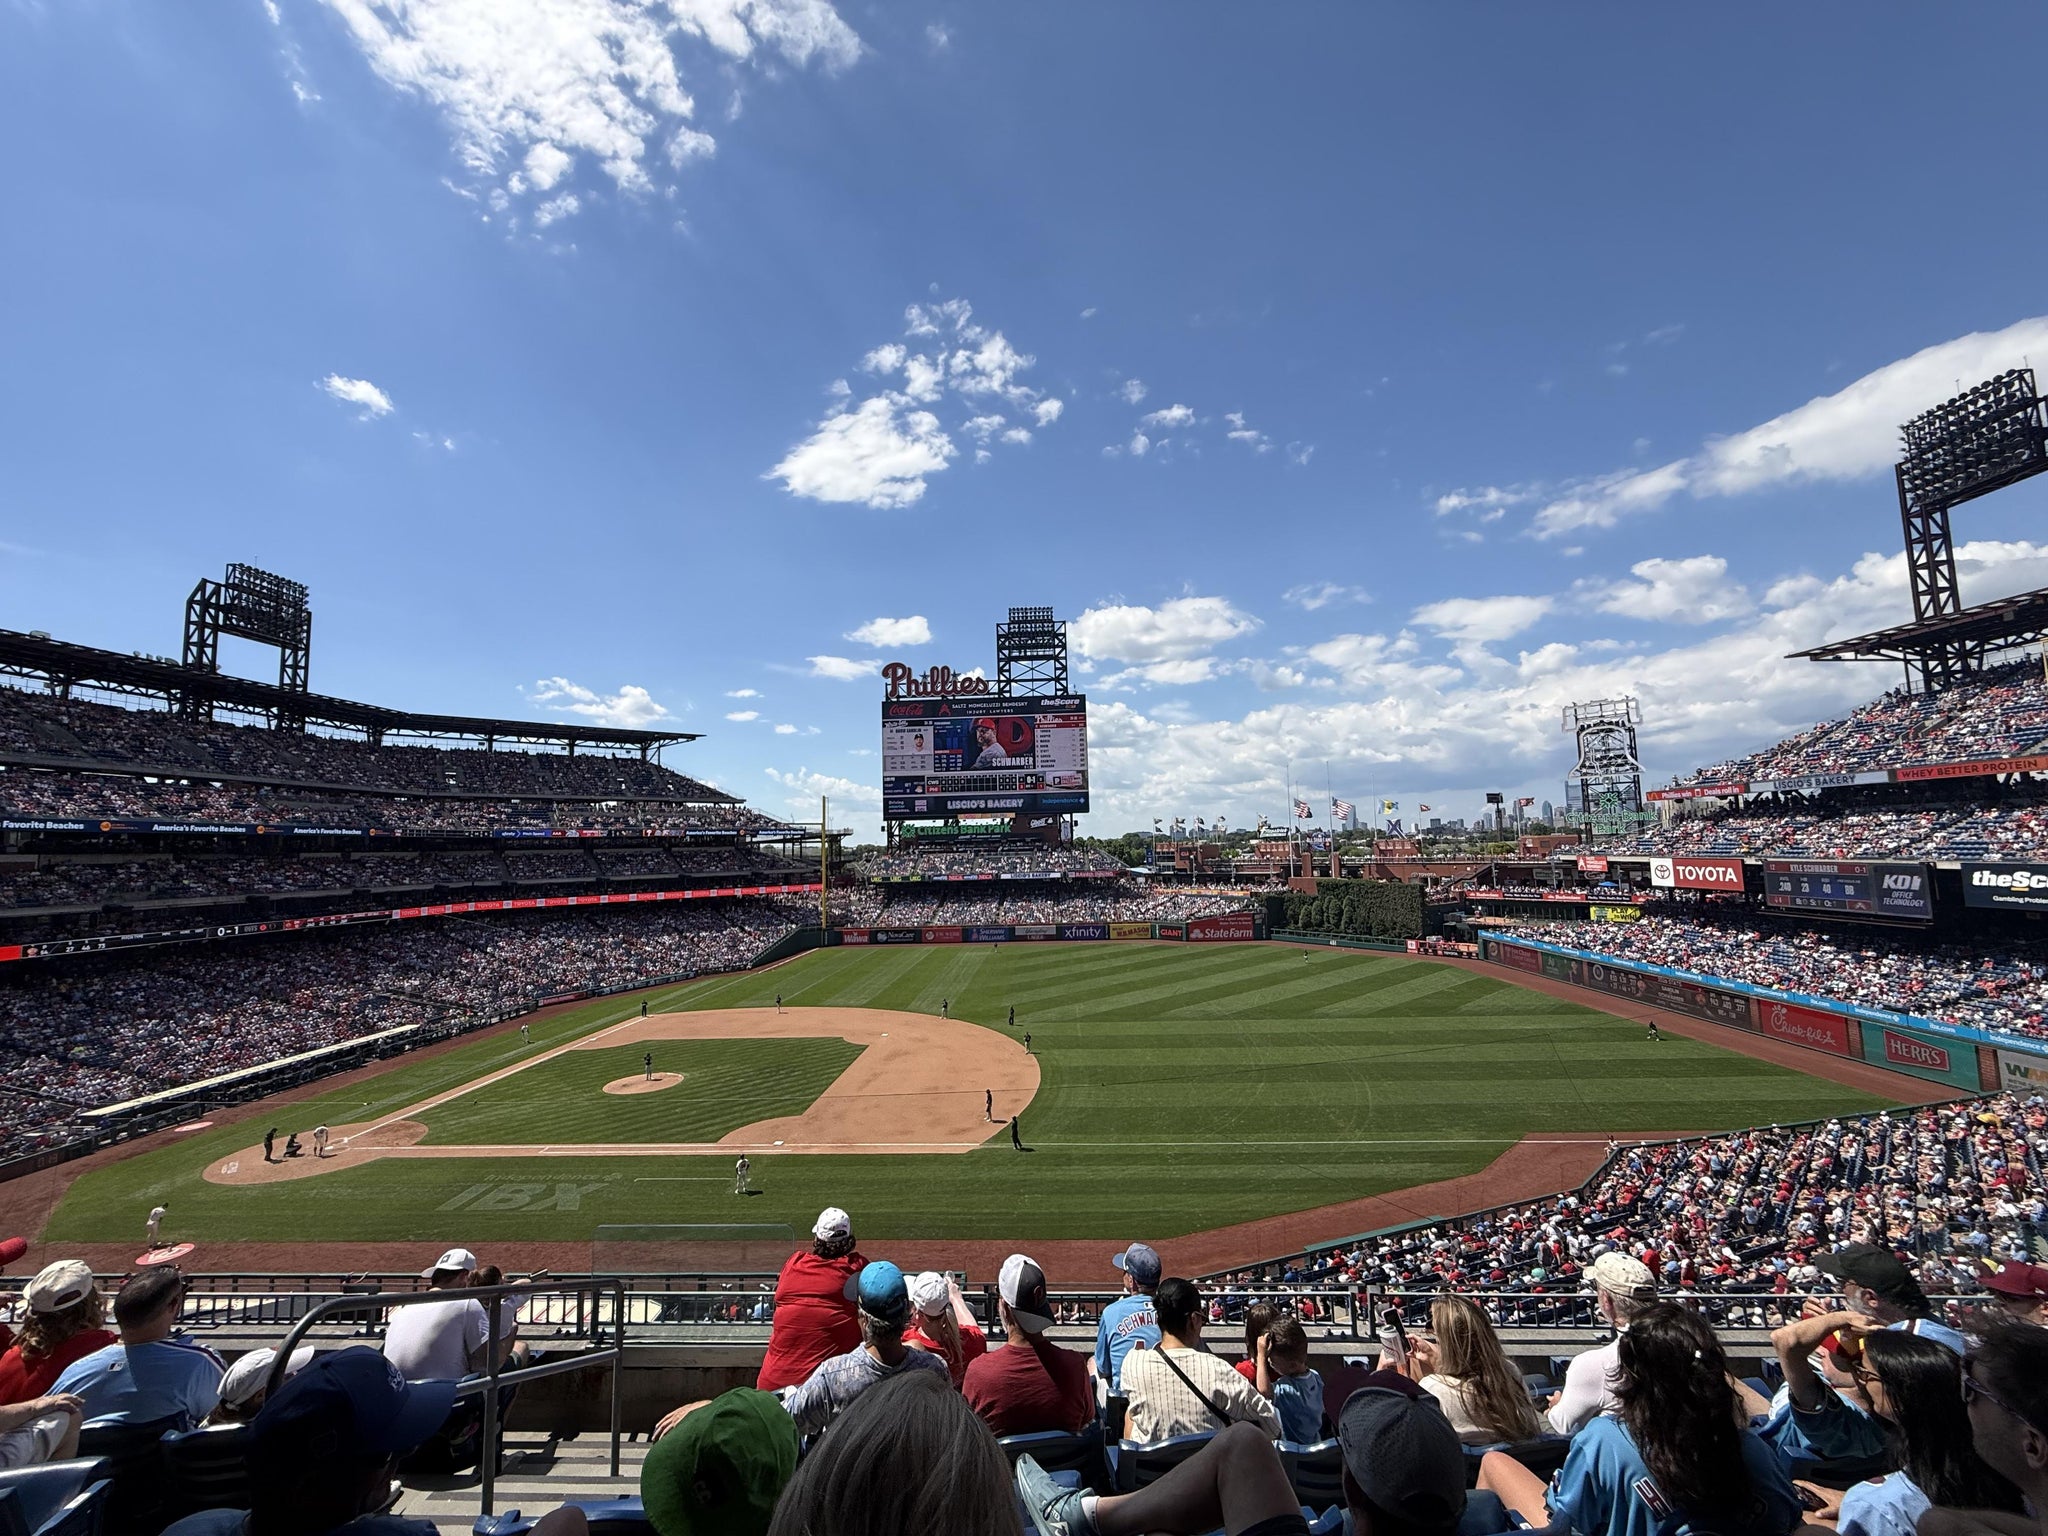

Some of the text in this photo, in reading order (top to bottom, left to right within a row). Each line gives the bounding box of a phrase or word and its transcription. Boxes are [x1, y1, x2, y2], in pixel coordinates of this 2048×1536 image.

[882, 662, 989, 698] Phillies
[1041, 698, 1079, 707] theScore
[992, 757, 1034, 767] SCHWARBER
[1902, 759, 2038, 779] WHEY BETTER PROTEIN
[1773, 774, 1857, 790] LISCIO'S BAKERY
[1661, 790, 1692, 799] Phillies win
[1704, 786, 1739, 796] Deals roll in
[947, 798, 1024, 810] LISCIO'S BAKERY
[1565, 809, 1658, 824] Citizens Bank
[2, 820, 85, 831] Favorite Beaches
[152, 824, 246, 834] America's Favorite Beaches
[917, 823, 1012, 836] Citizens Bank Park
[1595, 822, 1626, 835] Park
[293, 827, 362, 836] America's Favorite Beaches
[1790, 863, 1839, 873] KYLE SCHWARBER
[1676, 865, 1738, 883] TOYOTA
[1972, 870, 2048, 888] theSc
[1891, 890, 1913, 899] OFFICE
[1992, 895, 2024, 904] Gambling
[1882, 897, 1924, 907] TECHNOLOGY
[888, 931, 915, 939] NovaCare
[1064, 925, 1101, 938] xfinity
[1160, 929, 1183, 937] GIANT
[844, 934, 868, 943] Wawa
[1753, 987, 1783, 996] Independence
[1810, 998, 1830, 1007] ibx.com
[1854, 1008, 1892, 1020] Independence
[1771, 1009, 1837, 1046] Chick-fil-A
[1929, 1022, 1956, 1033] ibx.com
[1989, 1035, 2041, 1050] Independence
[1889, 1039, 1941, 1065] HERR'S
[433, 1183, 609, 1211] IBX
